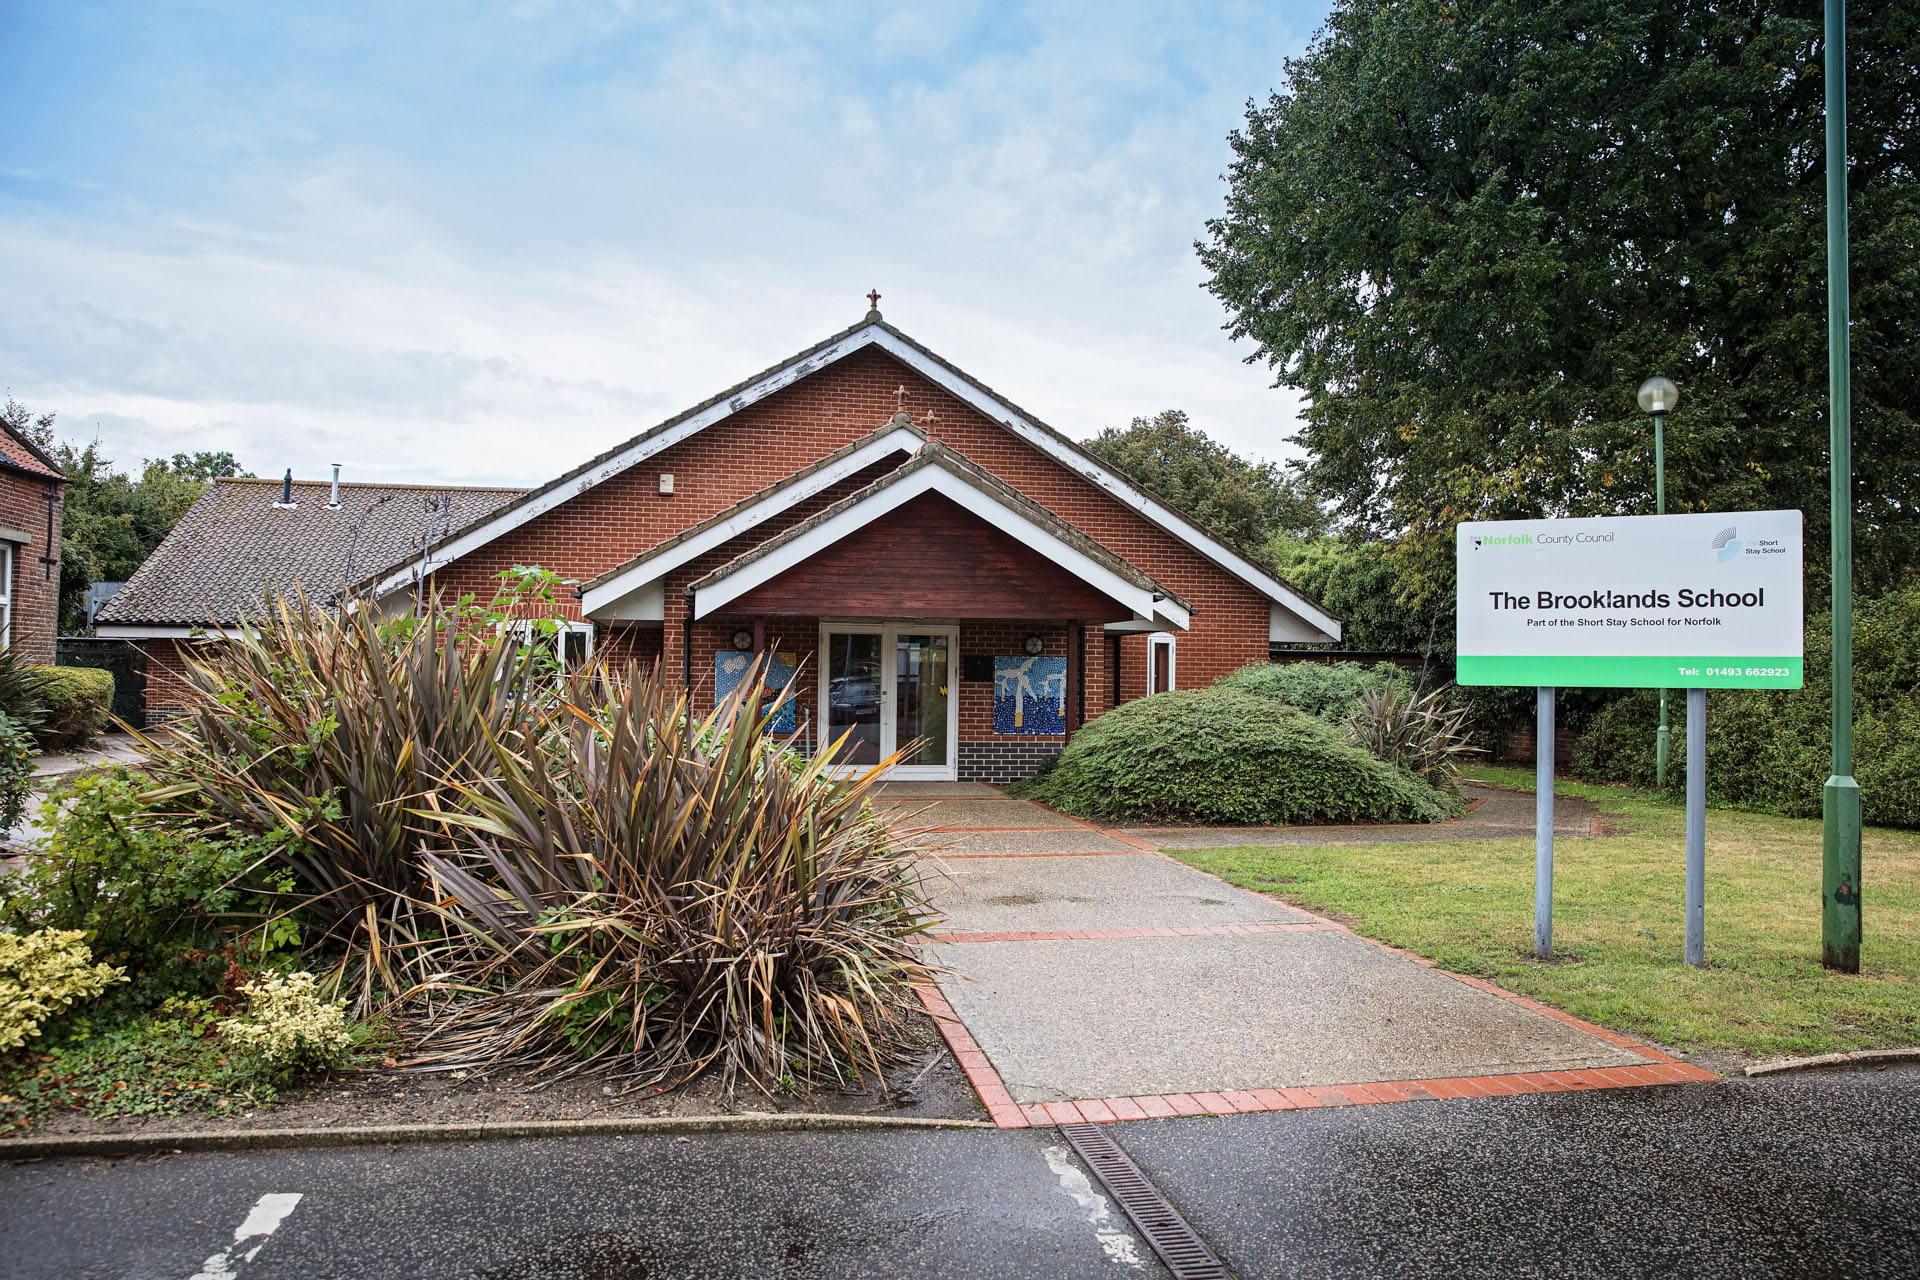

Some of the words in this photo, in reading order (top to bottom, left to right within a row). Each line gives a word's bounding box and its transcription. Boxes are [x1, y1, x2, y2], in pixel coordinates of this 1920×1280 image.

[1483, 533, 1533, 545] Norfolk
[1536, 533, 1574, 546] County
[1575, 532, 1615, 543] Council
[1489, 591, 1531, 610] The
[1537, 589, 1670, 610] Brooklands
[1677, 588, 1765, 608] School
[1527, 618, 1546, 627] Part
[1548, 618, 1558, 627] of
[1560, 618, 1575, 627] the
[1577, 618, 1604, 627] Short
[1606, 618, 1628, 628] Stay
[1630, 617, 1665, 627] School
[1667, 617, 1682, 626] for
[1684, 617, 1722, 626] Norfolk
[1678, 667, 1700, 676] Tel:
[1706, 667, 1742, 677] 01493
[1745, 667, 1790, 677] 662923
